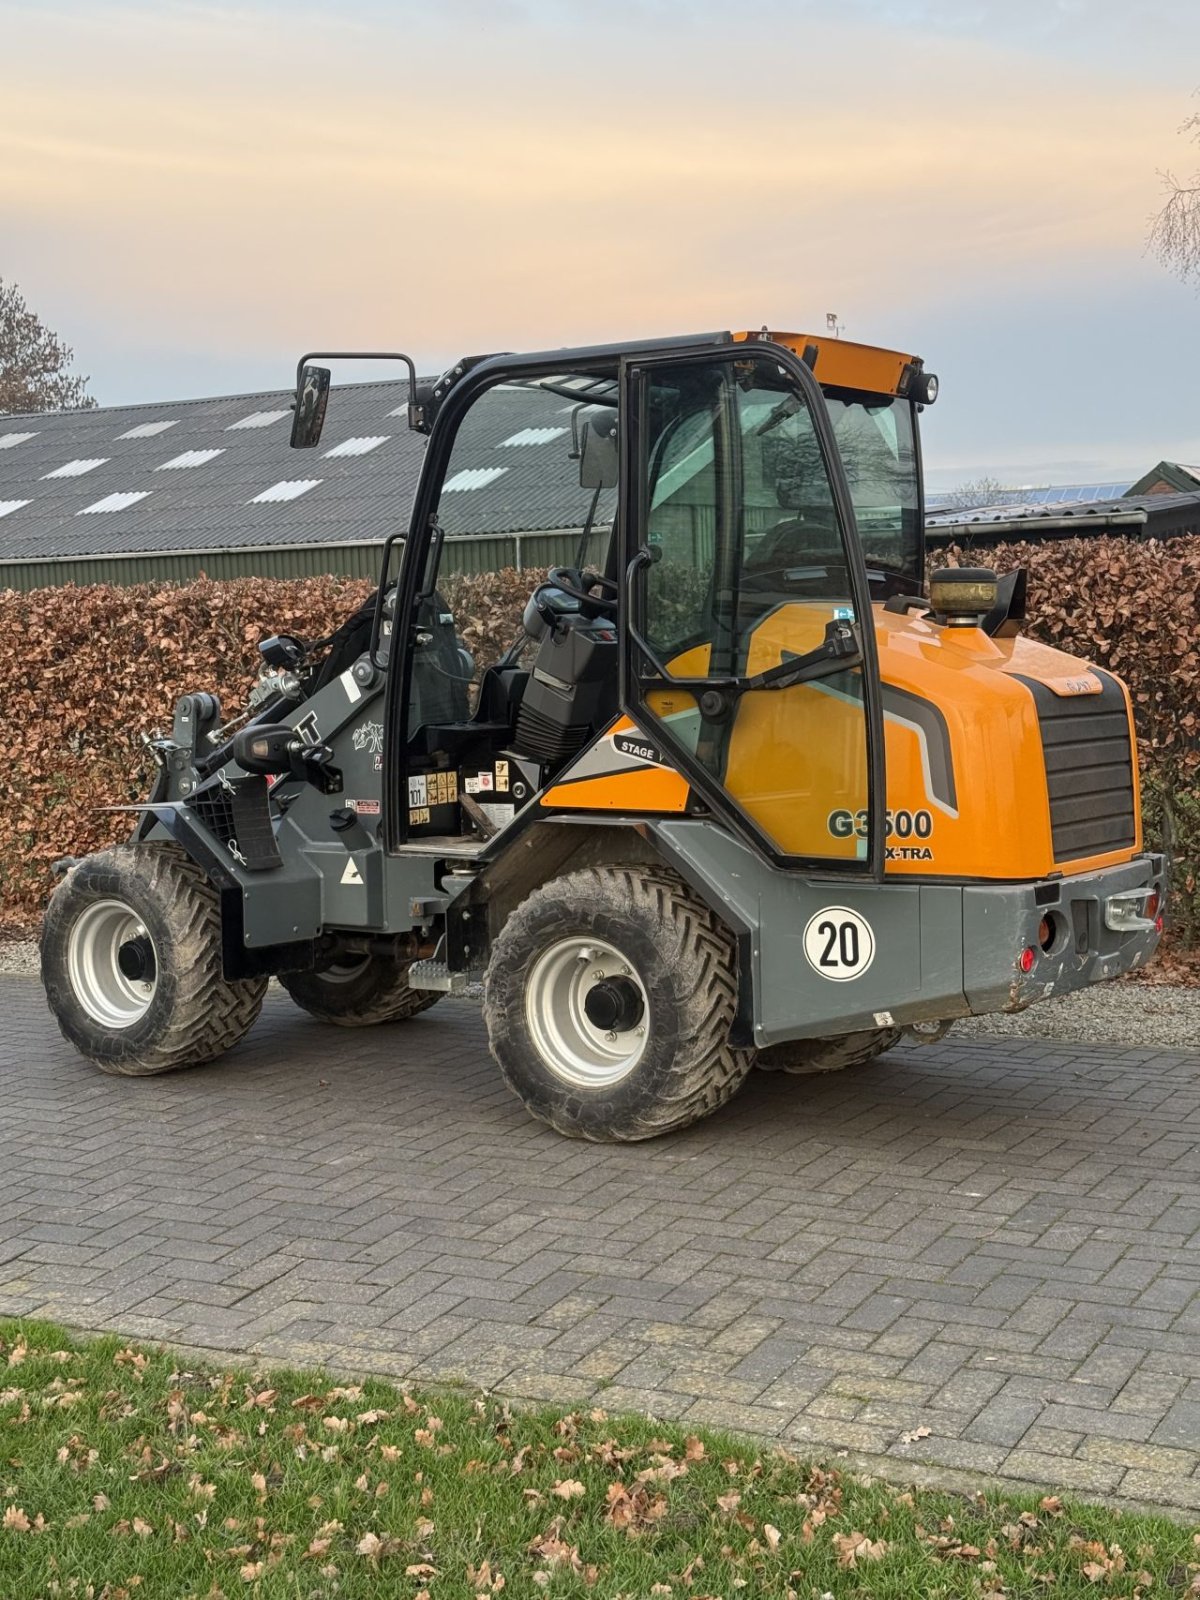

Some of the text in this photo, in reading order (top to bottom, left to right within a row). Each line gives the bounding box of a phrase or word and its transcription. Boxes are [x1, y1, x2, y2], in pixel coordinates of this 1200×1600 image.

[621, 741, 654, 759] STAGE
[885, 847, 933, 860] X-TRA
[818, 921, 860, 967] 20
